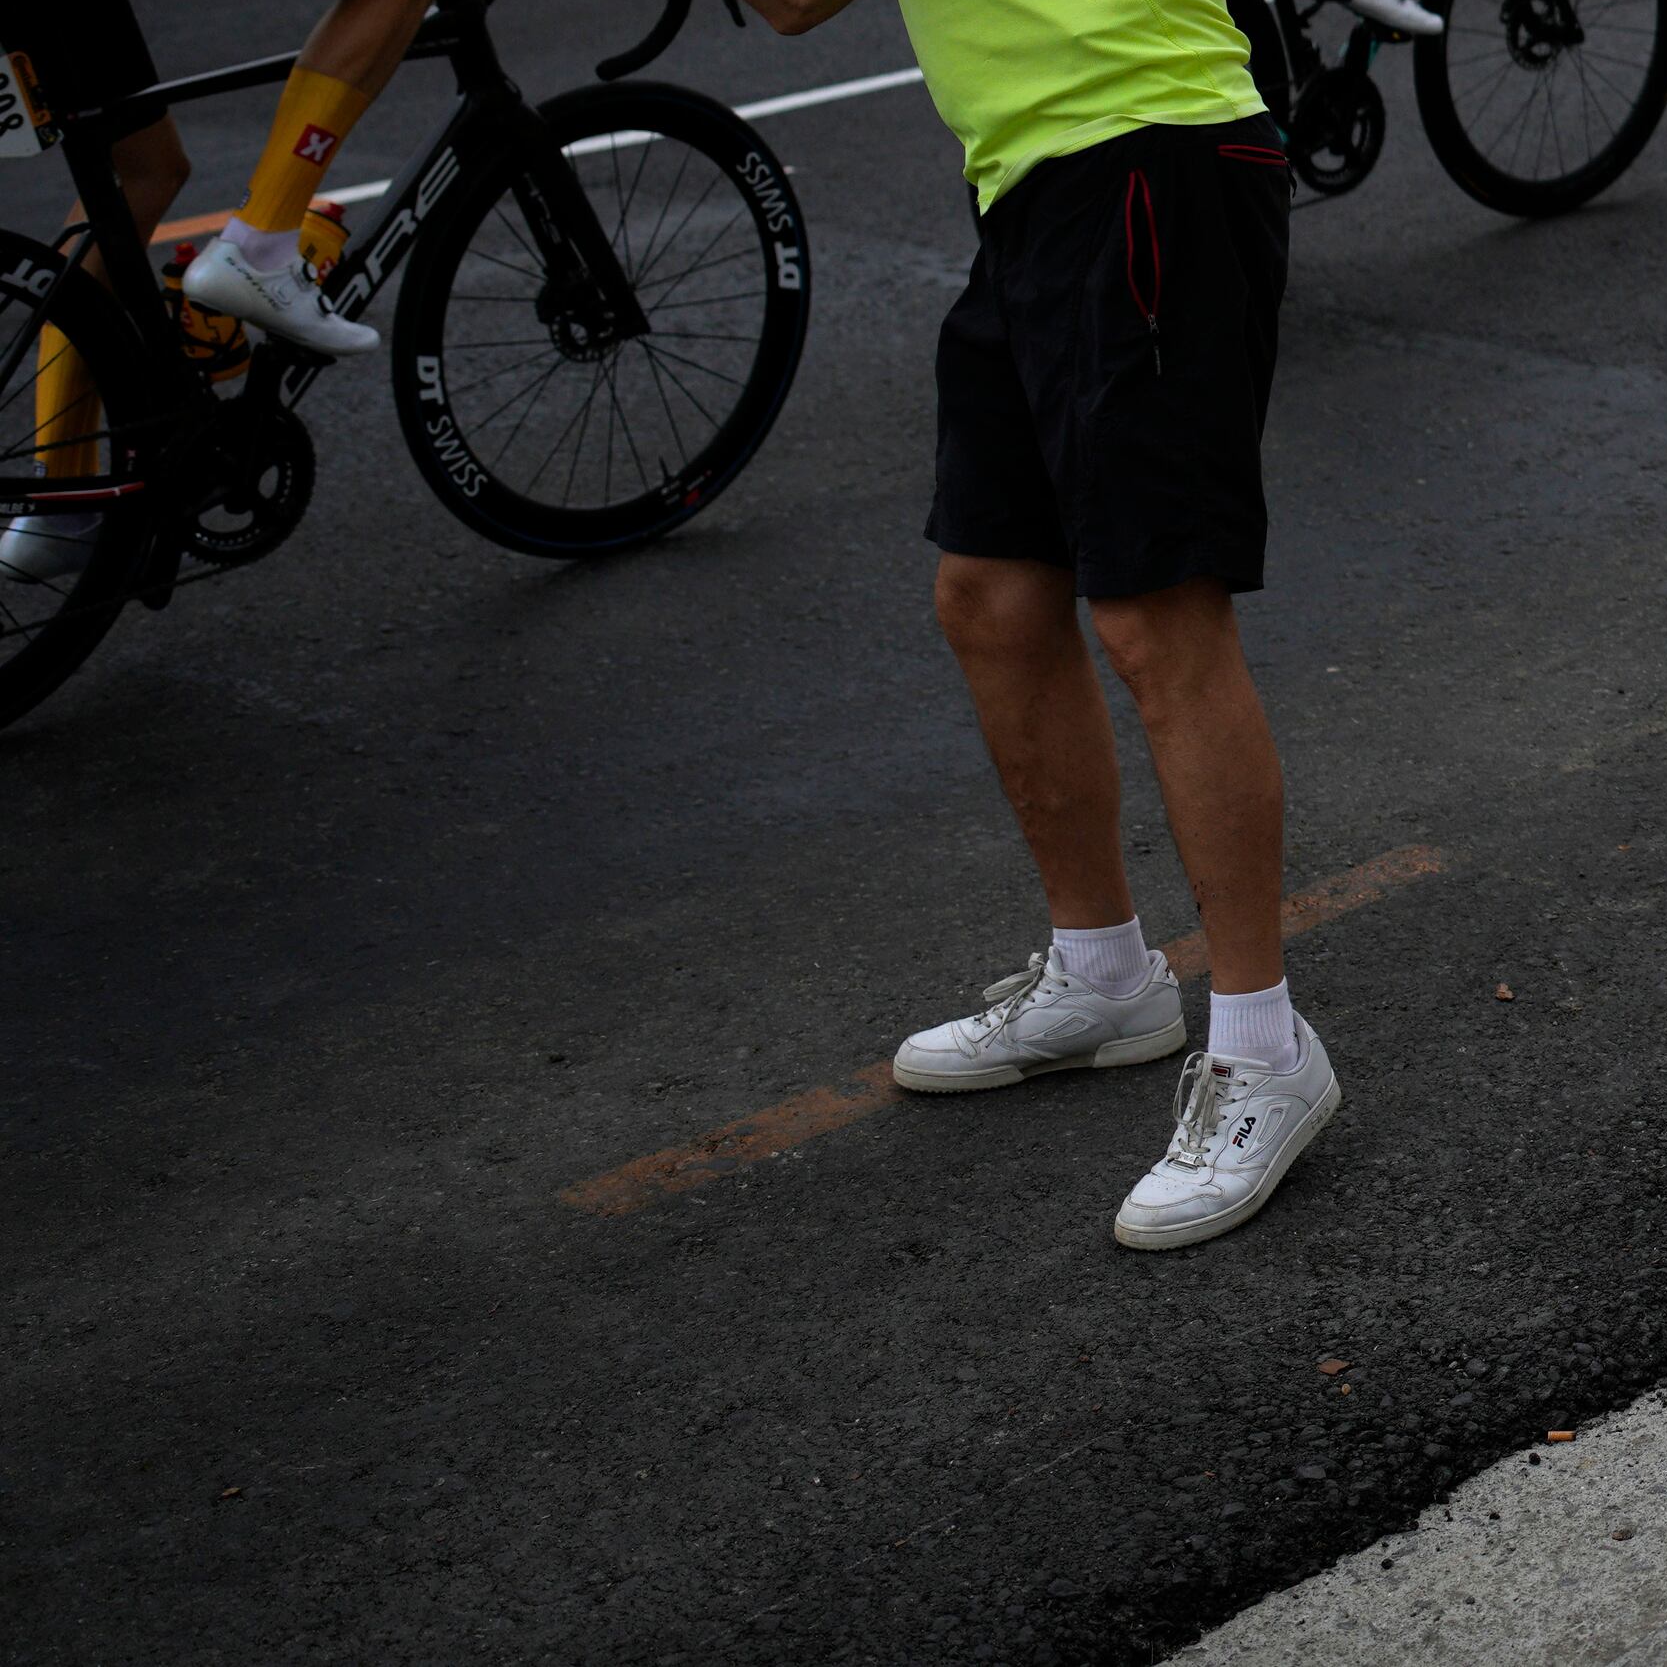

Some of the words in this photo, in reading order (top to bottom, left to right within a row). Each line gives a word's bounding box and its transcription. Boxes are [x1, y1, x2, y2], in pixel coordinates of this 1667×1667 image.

[736, 151, 795, 234] SWISS
[774, 241, 802, 291] DT
[416, 354, 445, 406] DT
[425, 414, 489, 498] SWISS
[1232, 1116, 1257, 1149] FILA
